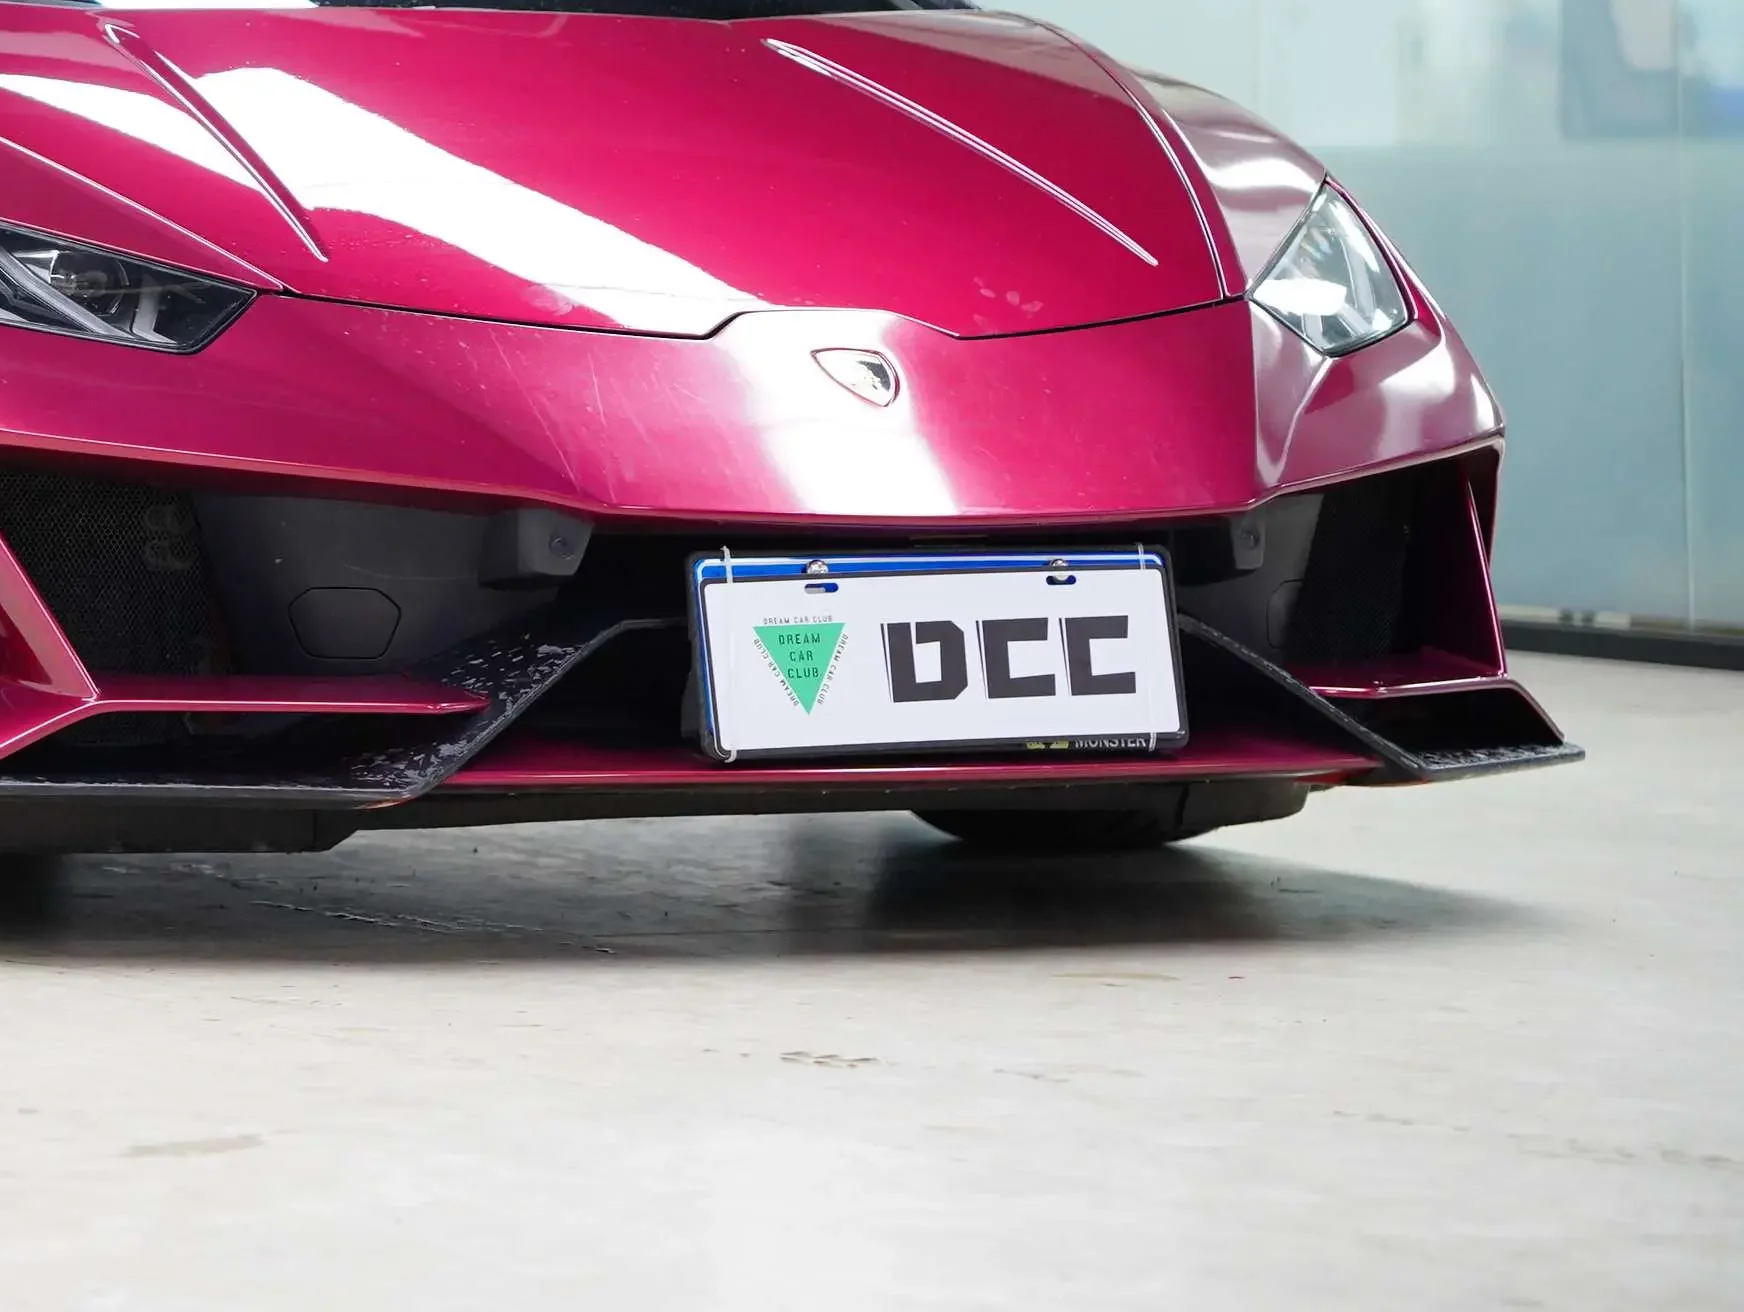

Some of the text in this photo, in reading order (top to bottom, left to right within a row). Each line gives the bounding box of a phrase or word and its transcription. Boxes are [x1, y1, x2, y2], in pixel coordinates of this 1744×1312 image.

[763, 615, 833, 625] DREAM CAR CLUB
[778, 633, 821, 645] DREAM
[789, 650, 813, 662] CAR
[880, 615, 1136, 703] DCC
[787, 667, 819, 679] CLUB
